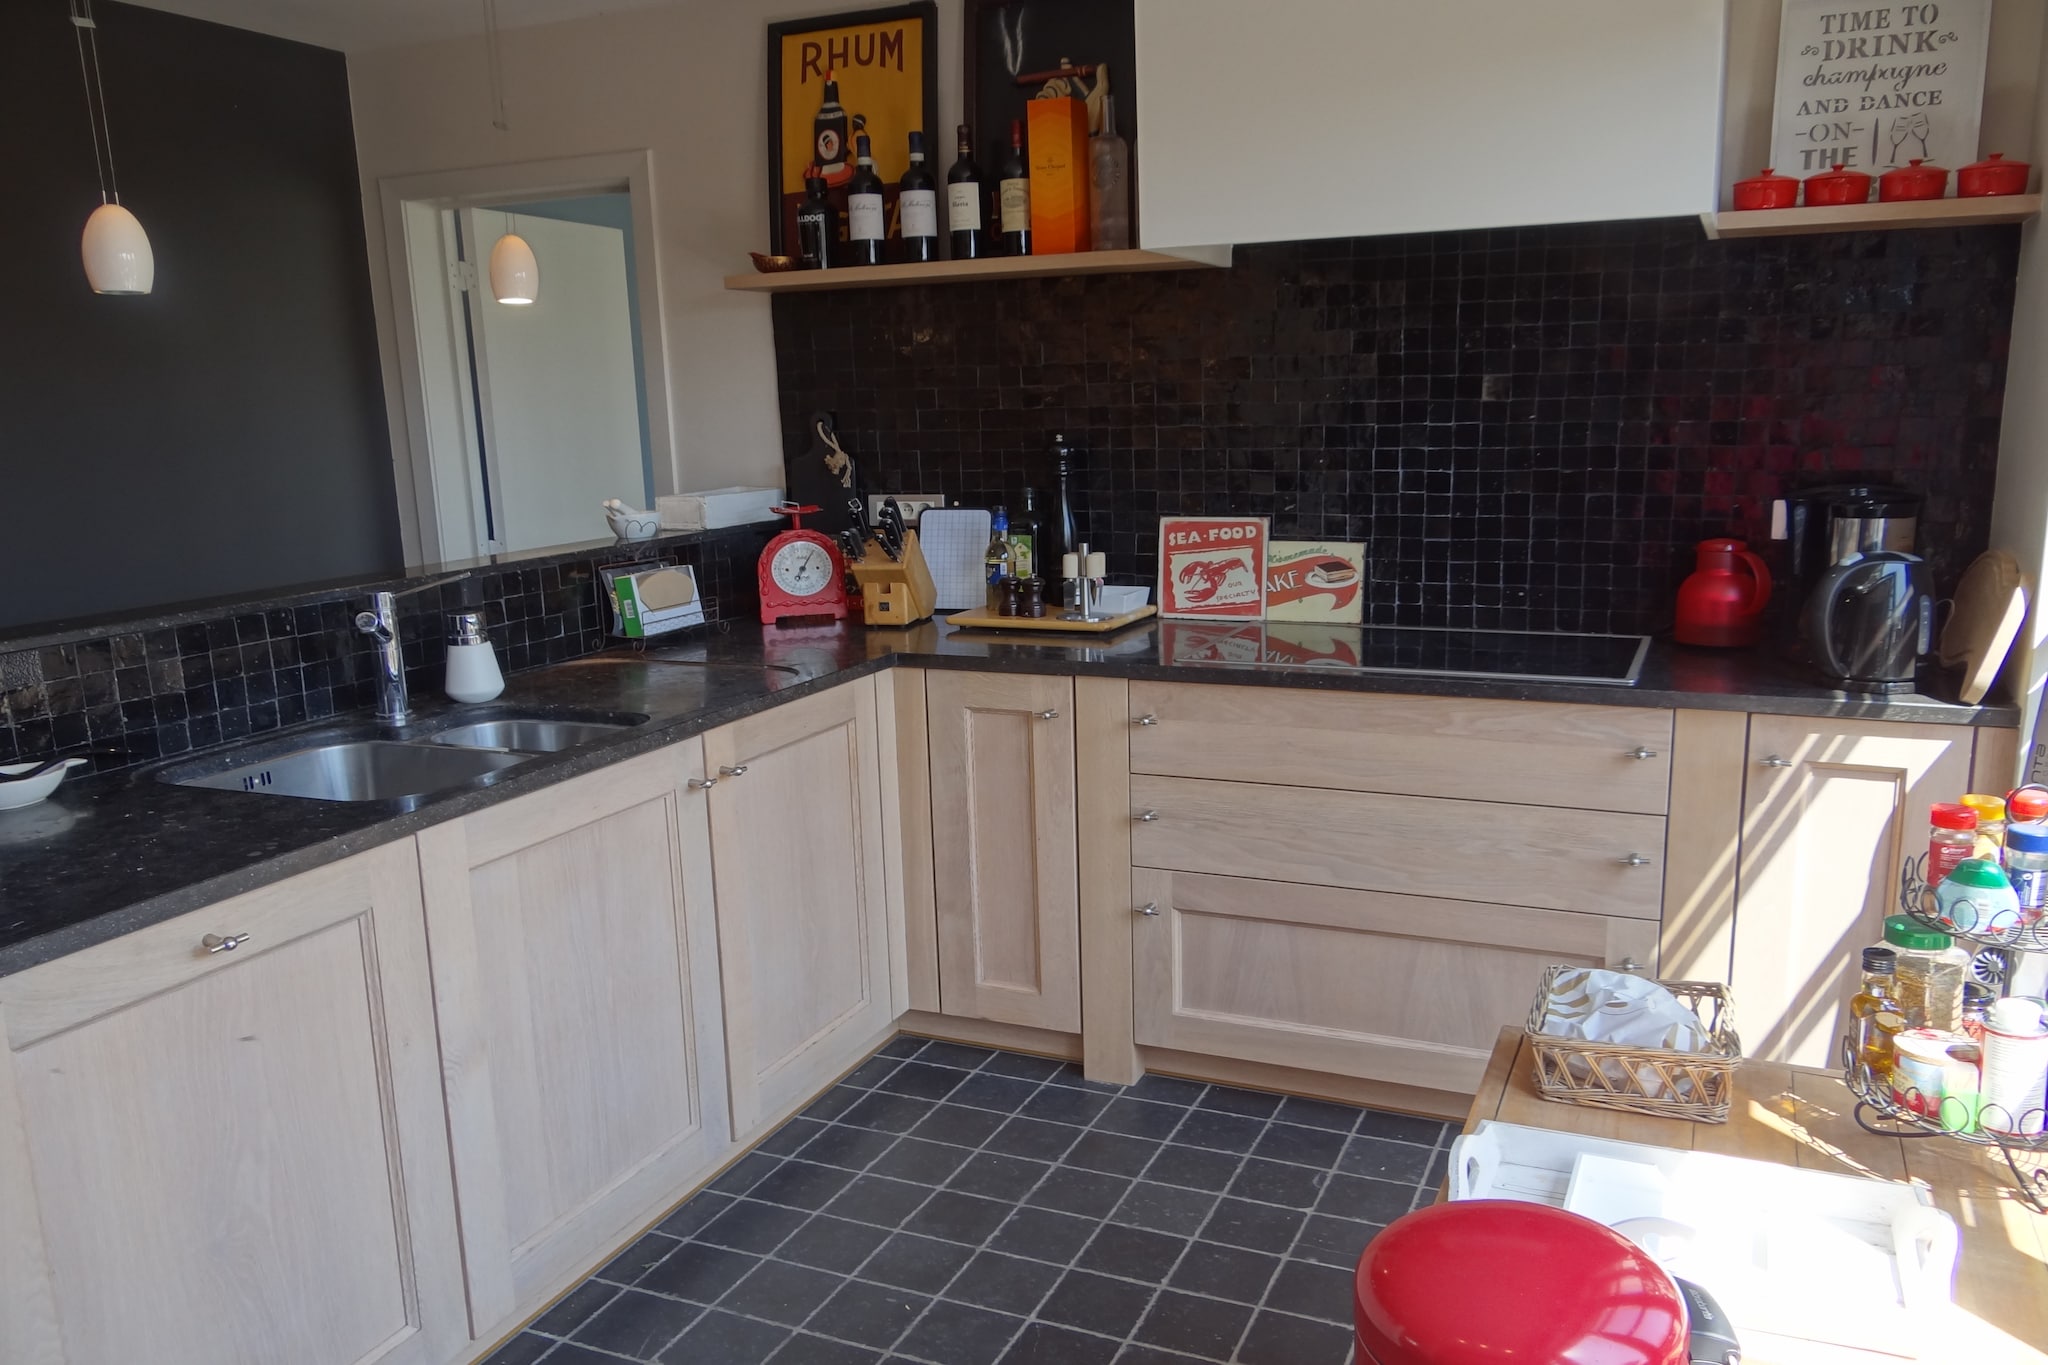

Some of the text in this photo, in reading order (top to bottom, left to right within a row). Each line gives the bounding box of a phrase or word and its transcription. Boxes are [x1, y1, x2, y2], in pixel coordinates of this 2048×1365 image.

[1820, 3, 1940, 35] TIME TO
[801, 28, 904, 84] RHUM
[1823, 30, 1939, 61] DRINK
[1802, 61, 1948, 92] champagne
[1796, 90, 1943, 117] AND DANCE
[1800, 147, 1859, 171] THE
[1227, 580, 1244, 589] OUR
[1266, 570, 1303, 592] AKE
